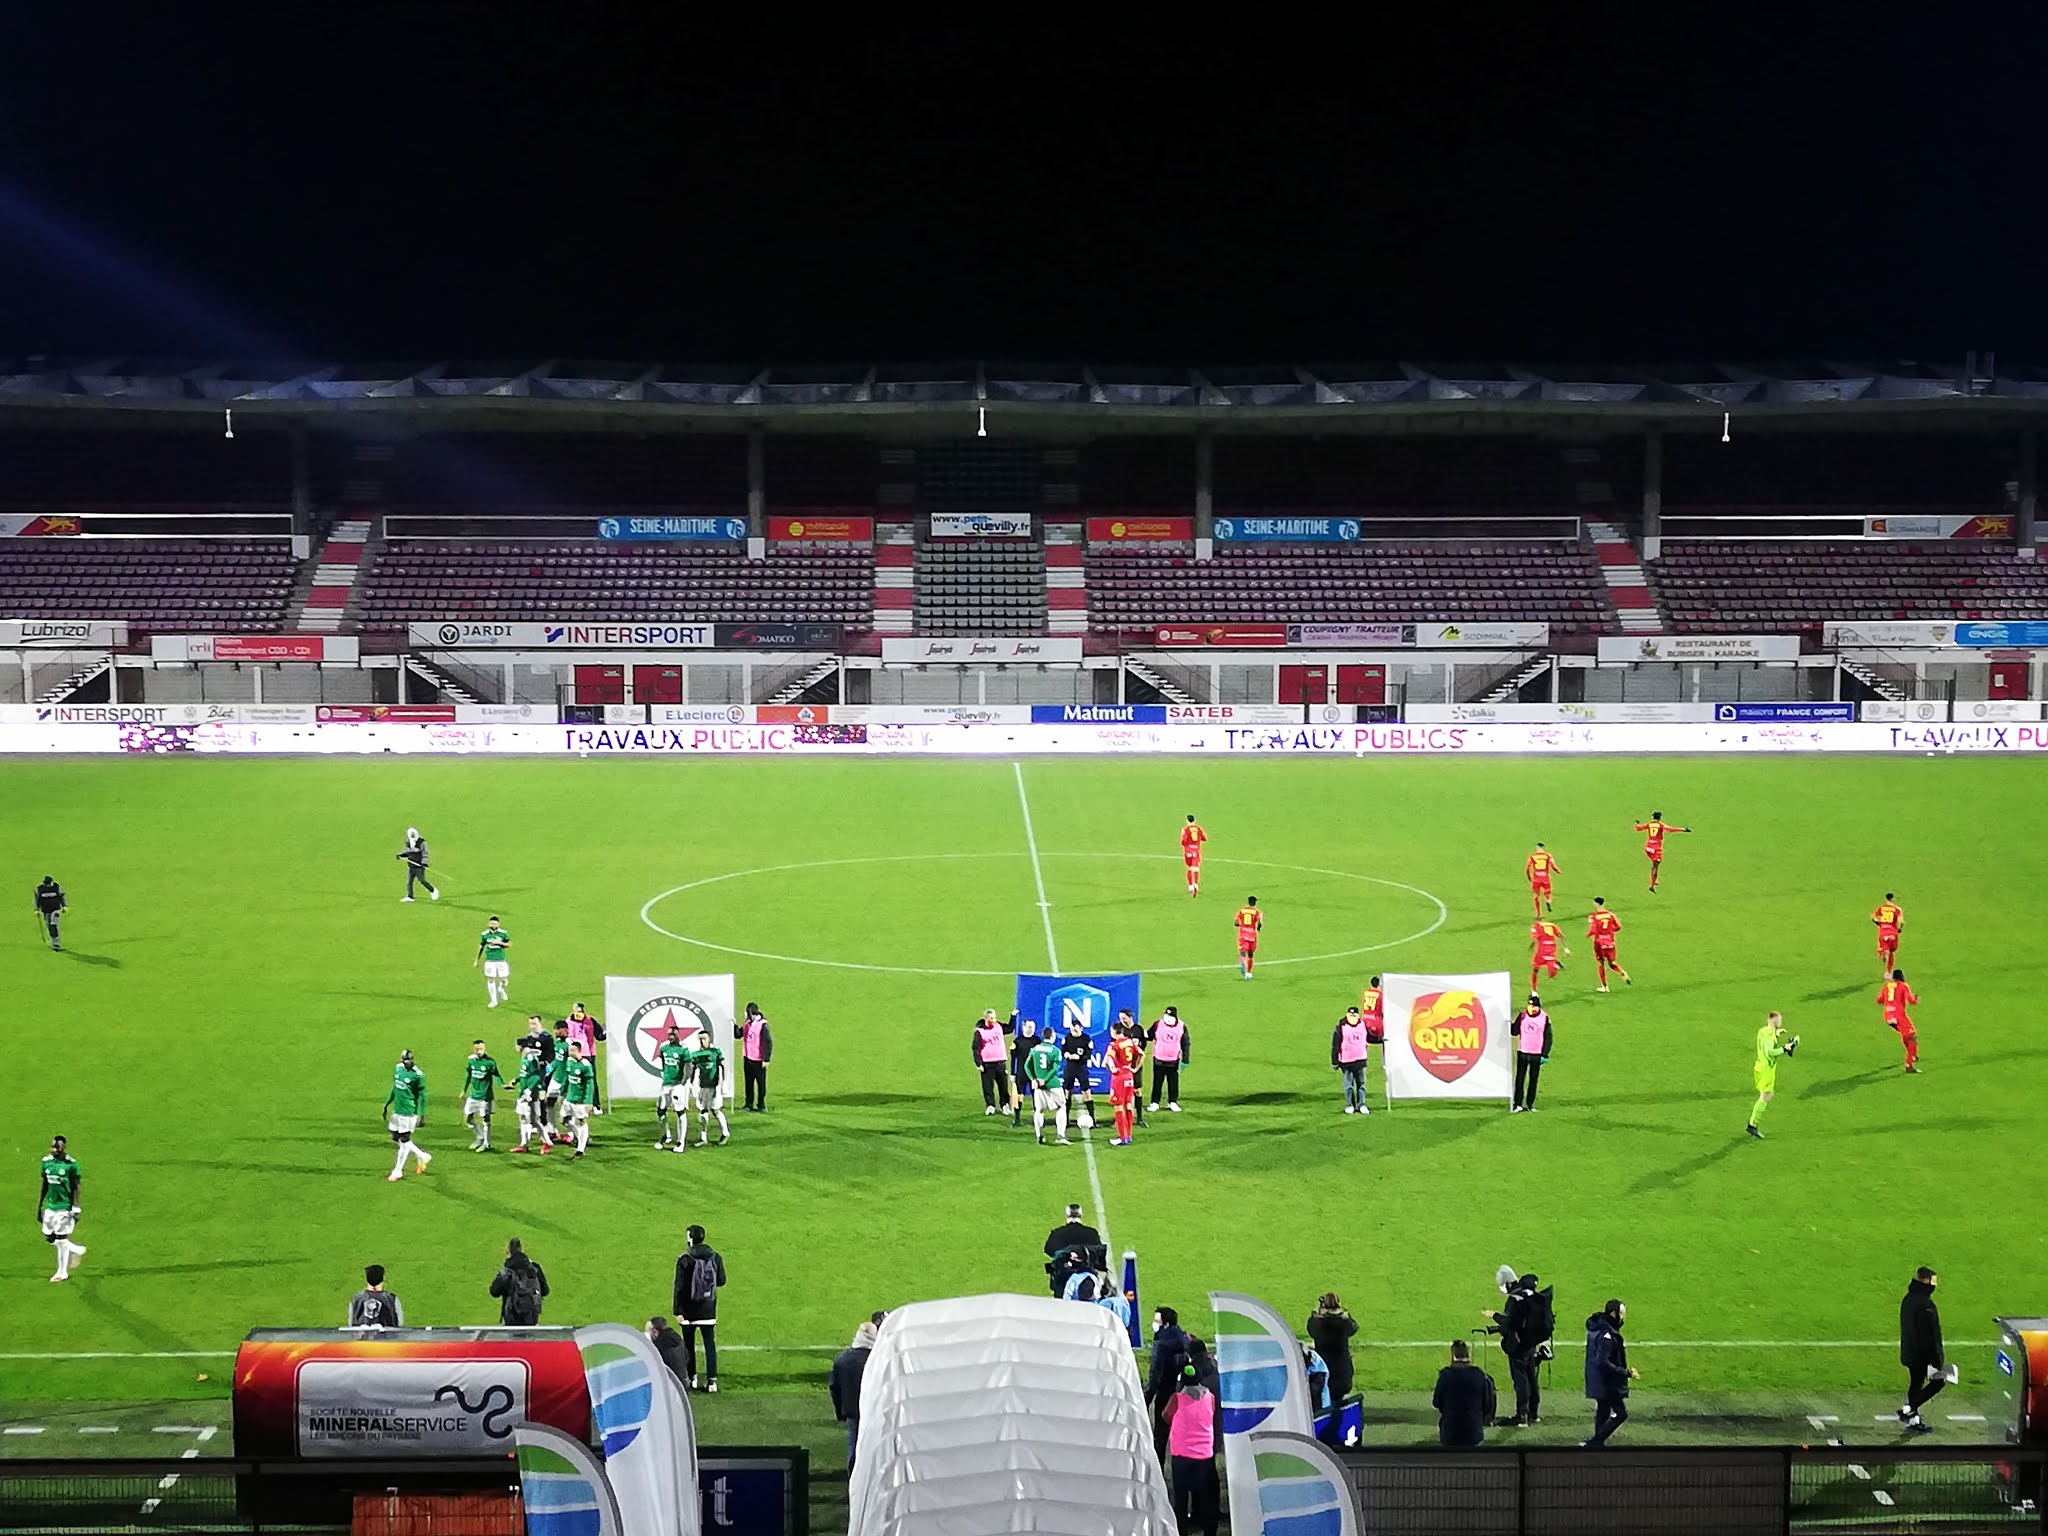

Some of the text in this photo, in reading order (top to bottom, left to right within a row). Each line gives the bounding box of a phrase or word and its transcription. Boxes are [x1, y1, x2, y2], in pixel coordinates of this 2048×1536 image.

[629, 518, 718, 534] SEINE-MARITIME
[972, 520, 1030, 533] quevilly.fr
[1243, 519, 1330, 535] SEINE-MARITIME
[21, 622, 92, 637] Lubrizol
[462, 625, 513, 637] JARDI
[567, 626, 708, 644] INTERSPORT
[1303, 625, 1400, 634] COUPIGNY TRAITEUR
[1675, 640, 1752, 648] RESTAURANT DE
[1714, 650, 1760, 658] KARAOKE
[54, 707, 169, 722] INTERSPORT
[665, 710, 726, 721] E.Leclerc
[1063, 704, 1135, 721] Matmut
[1168, 706, 1234, 718] SATEB
[1776, 708, 1812, 716] FRANCE
[1354, 728, 1468, 750] PUBLICS
[639, 997, 702, 1016] RED STAR FC
[1363, 996, 1377, 1011] 24
[1062, 996, 1093, 1030] N
[1414, 1027, 1480, 1054] QRM
[1039, 1053, 1048, 1069] 3
[1124, 1047, 1133, 1062] 5
[309, 1417, 468, 1432] MINERALSERVICE
